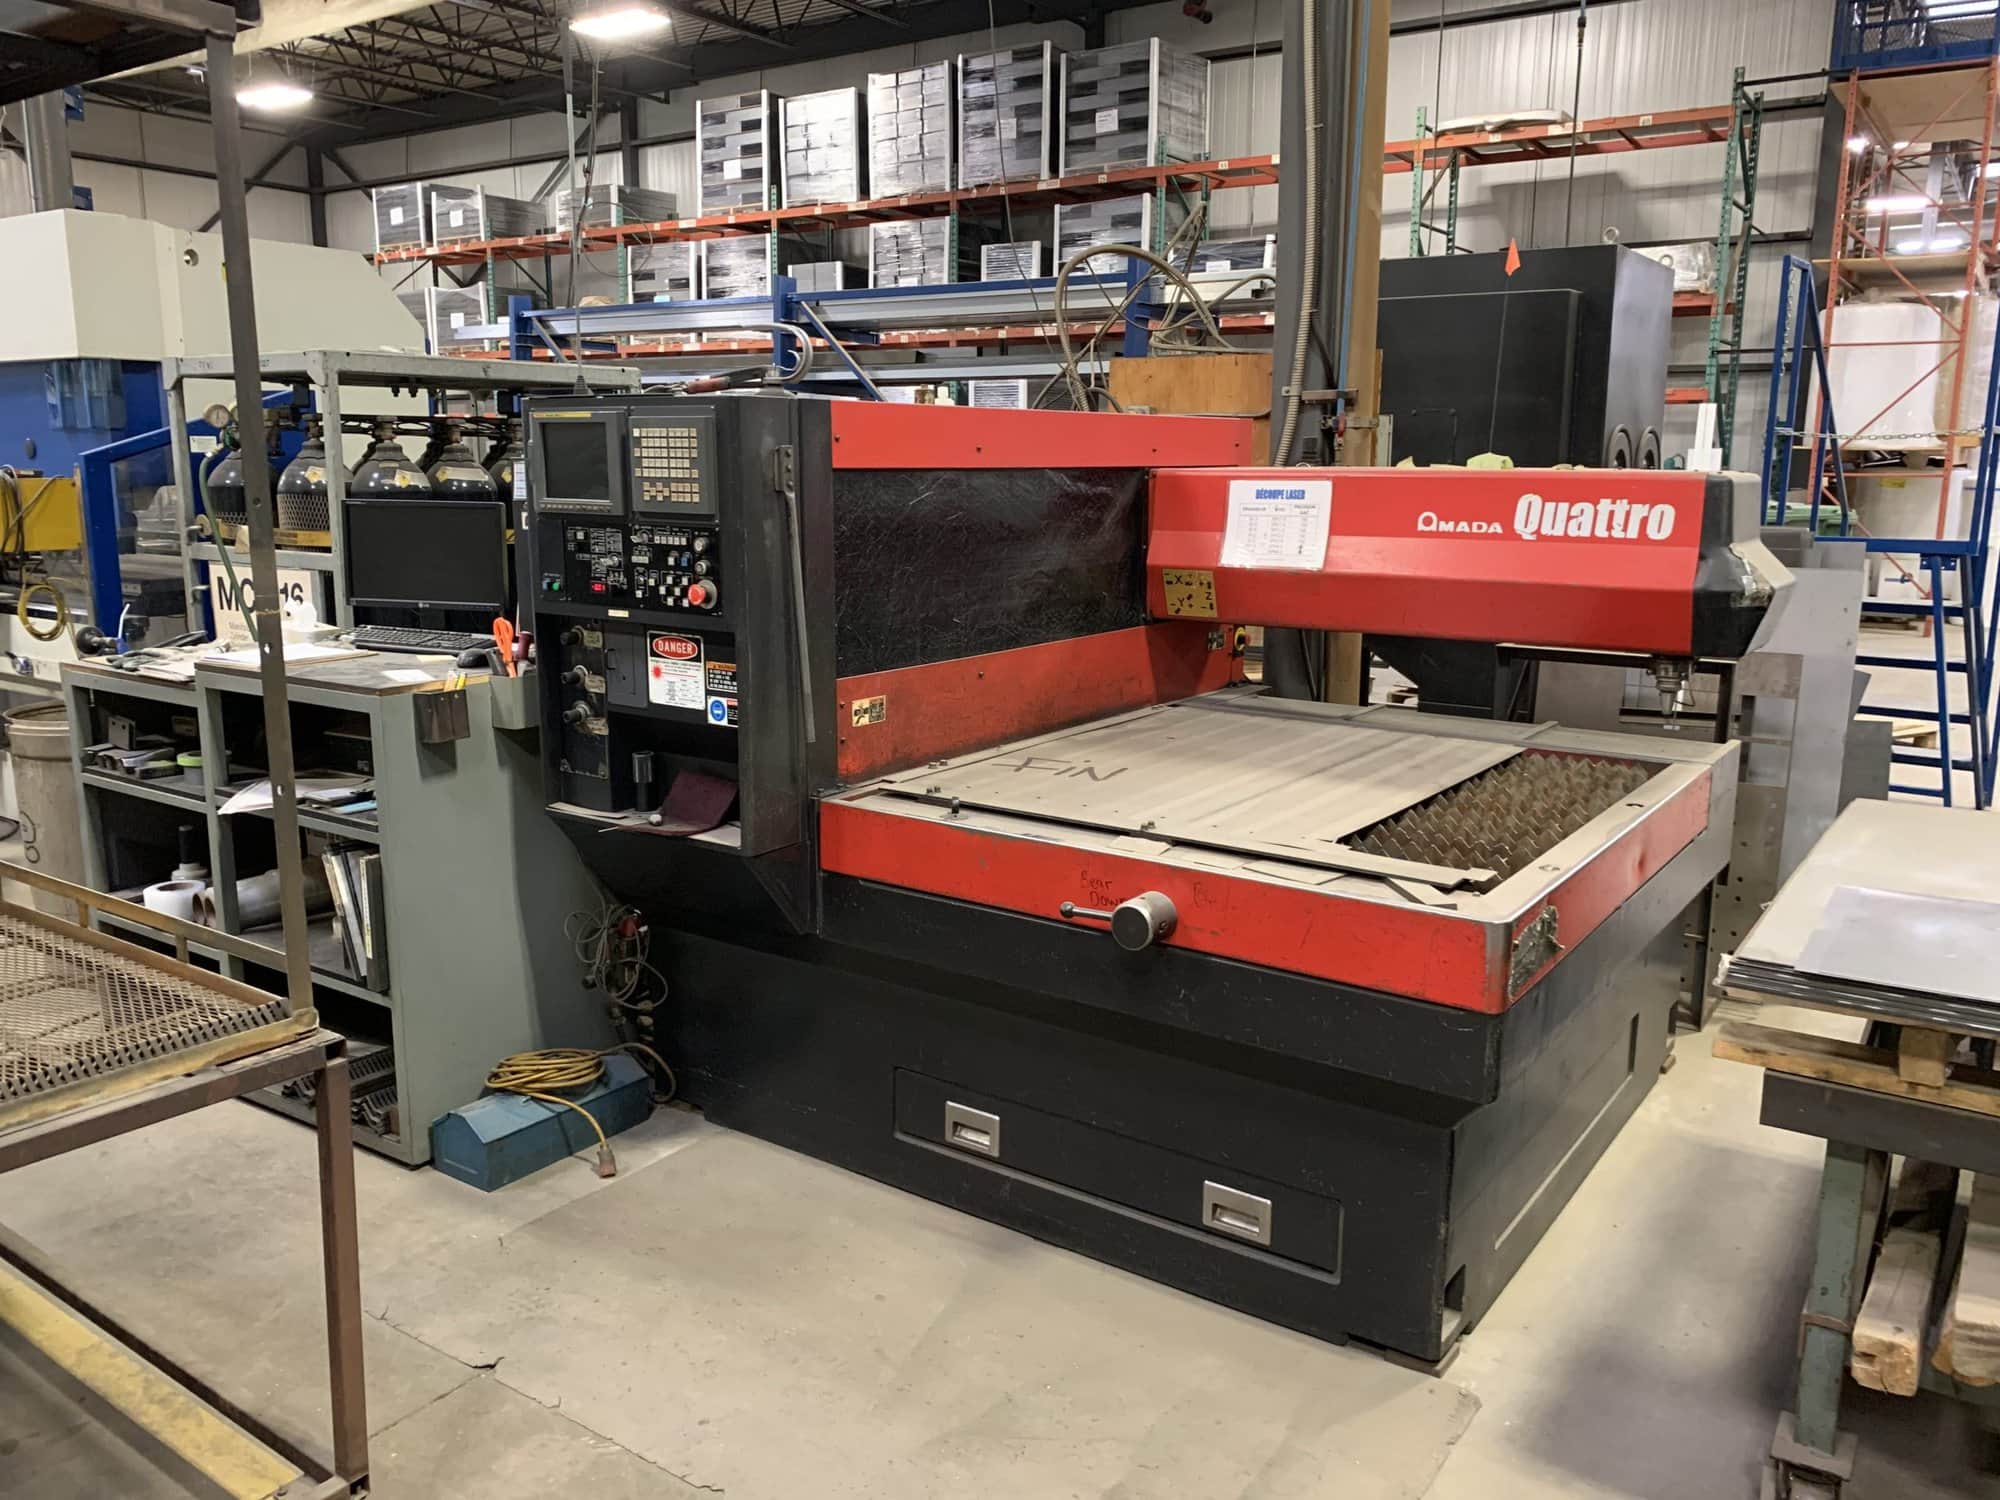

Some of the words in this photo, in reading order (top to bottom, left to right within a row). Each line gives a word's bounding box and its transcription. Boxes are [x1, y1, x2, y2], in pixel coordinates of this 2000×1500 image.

[1285, 489, 1306, 499] LASER
[1513, 493, 1676, 540] Quattro
[658, 640, 693, 656] DANGER
